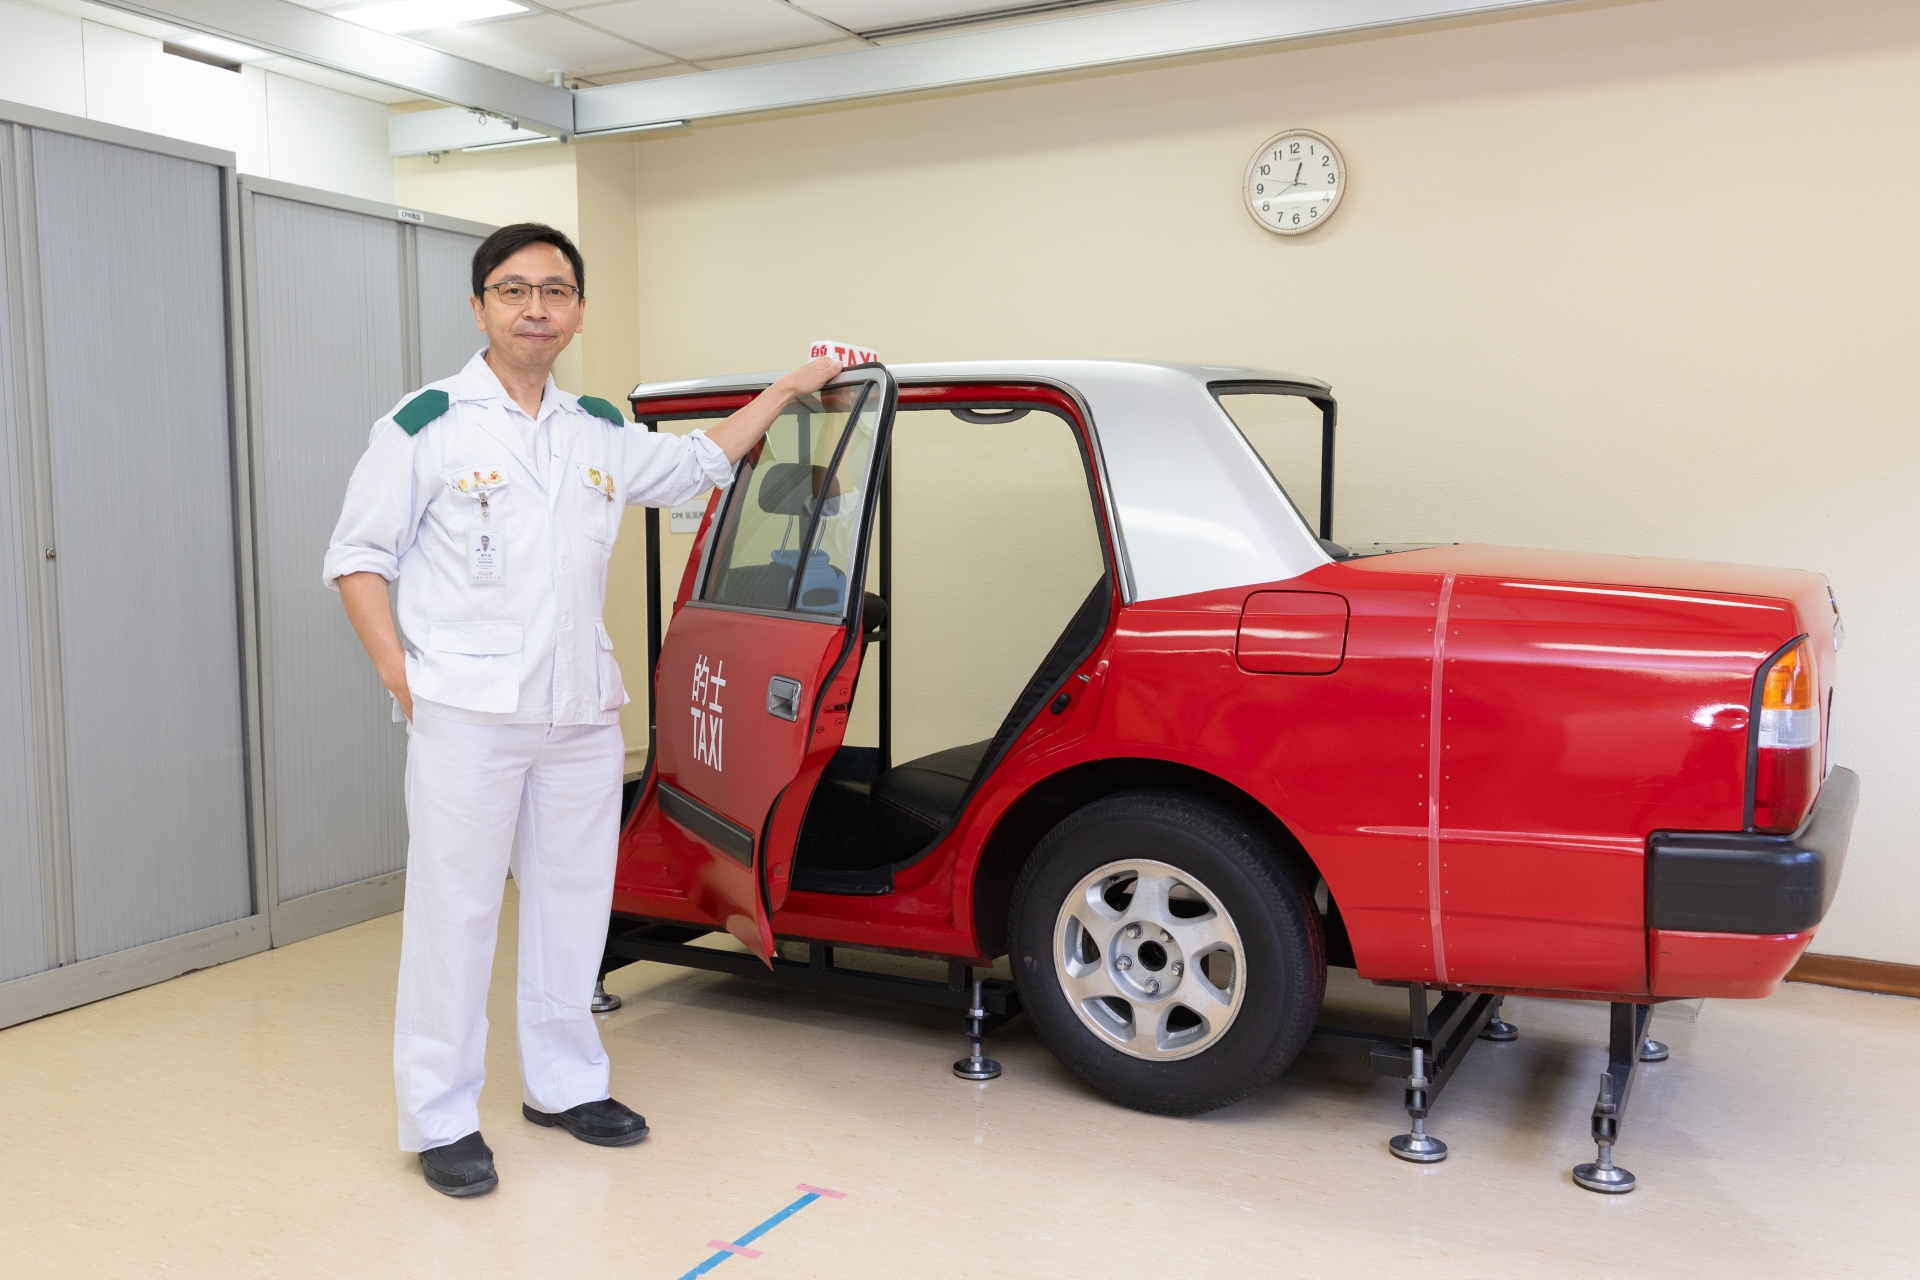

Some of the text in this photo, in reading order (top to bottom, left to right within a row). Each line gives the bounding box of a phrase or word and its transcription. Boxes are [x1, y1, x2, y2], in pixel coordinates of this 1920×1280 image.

[1290, 142, 1300, 154] 12
[1310, 145, 1314, 155] 1
[1274, 150, 1282, 161] 11
[1322, 155, 1330, 167] 2
[1260, 164, 1271, 176] 10
[1327, 172, 1336, 184] 3
[1256, 183, 1264, 194] 9
[1322, 192, 1330, 203] 4
[1262, 200, 1270, 212] 8
[1310, 206, 1318, 218] 5
[1277, 211, 1284, 223] 7
[1292, 213, 1300, 225] 6
[671, 512, 684, 520] CPR
[691, 653, 727, 714] 的士
[690, 706, 723, 773] TAXI
